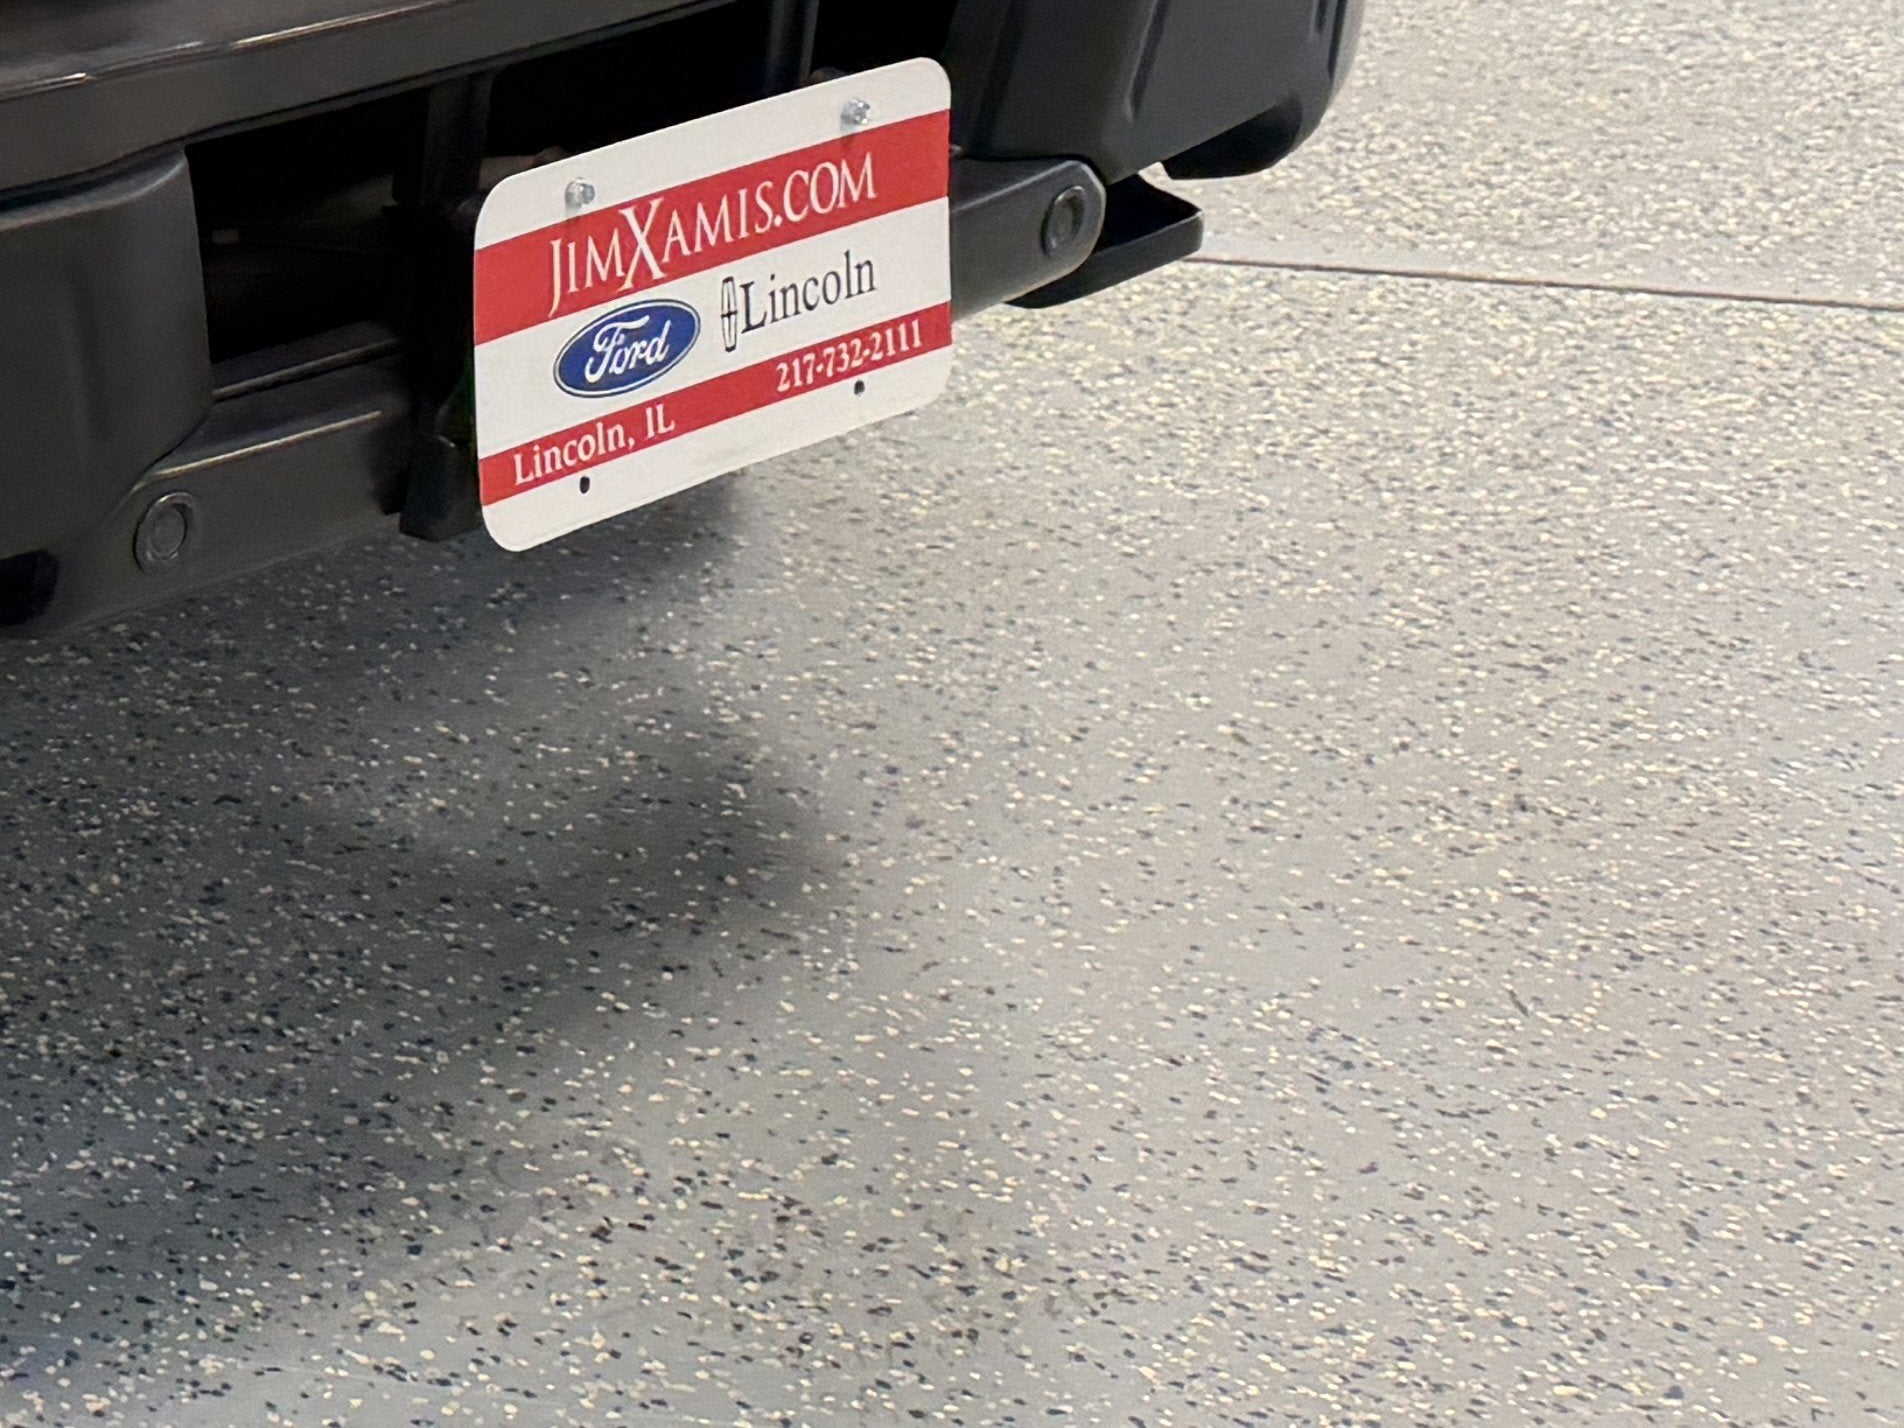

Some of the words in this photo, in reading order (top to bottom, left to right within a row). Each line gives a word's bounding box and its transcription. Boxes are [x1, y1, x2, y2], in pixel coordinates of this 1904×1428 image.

[547, 151, 878, 319] JIMXAMIS.COM
[739, 249, 878, 334] Lincoln
[583, 314, 672, 384] Ford
[775, 318, 923, 393] 217-732-2111
[513, 421, 636, 486] Lincoln,
[644, 402, 676, 440] IL
